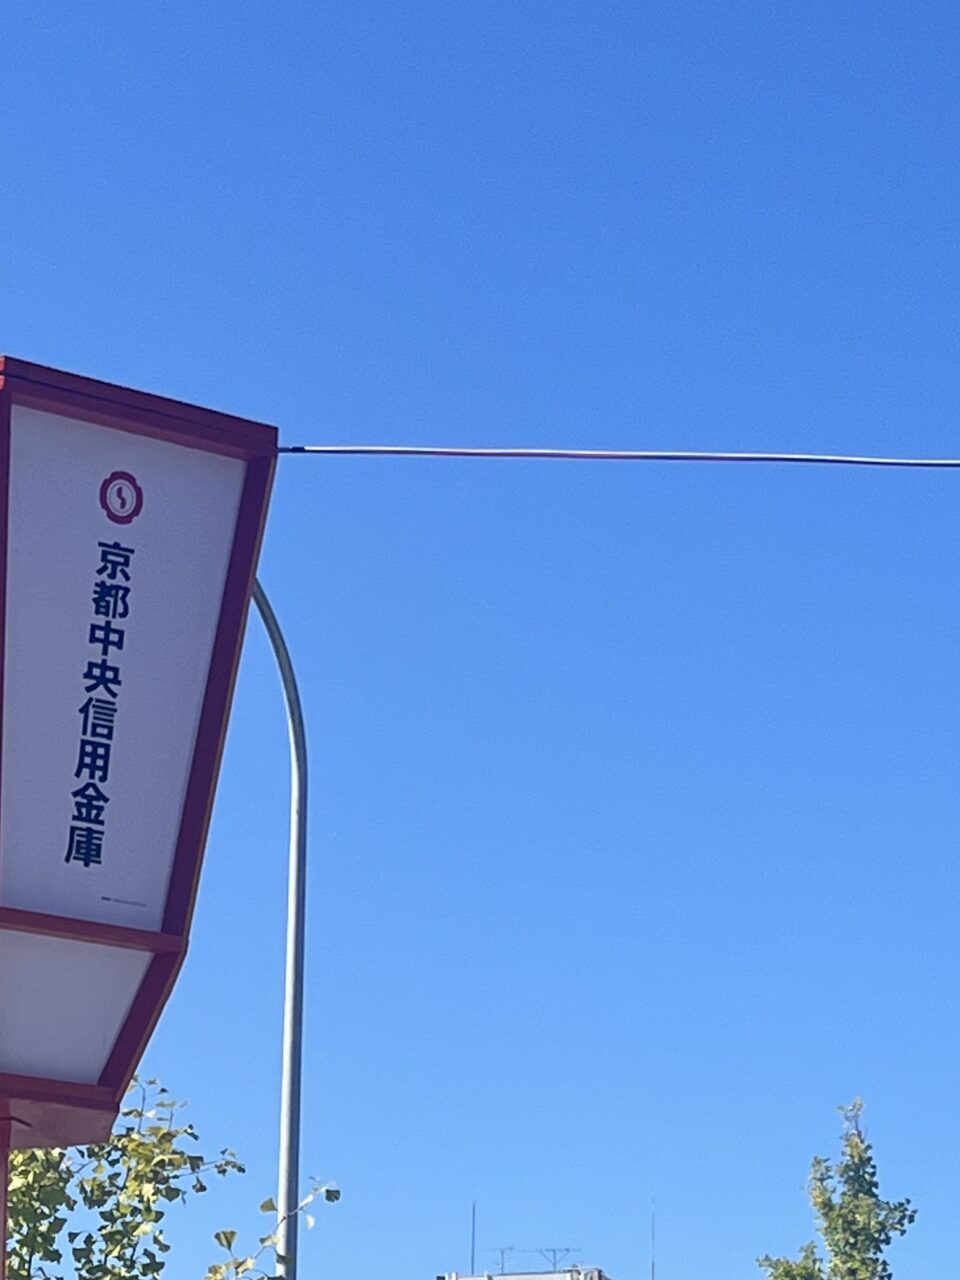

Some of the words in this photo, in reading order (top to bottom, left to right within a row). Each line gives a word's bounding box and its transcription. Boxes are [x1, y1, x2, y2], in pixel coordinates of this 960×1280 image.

[63, 541, 135, 868] 京都中央信用金庫
